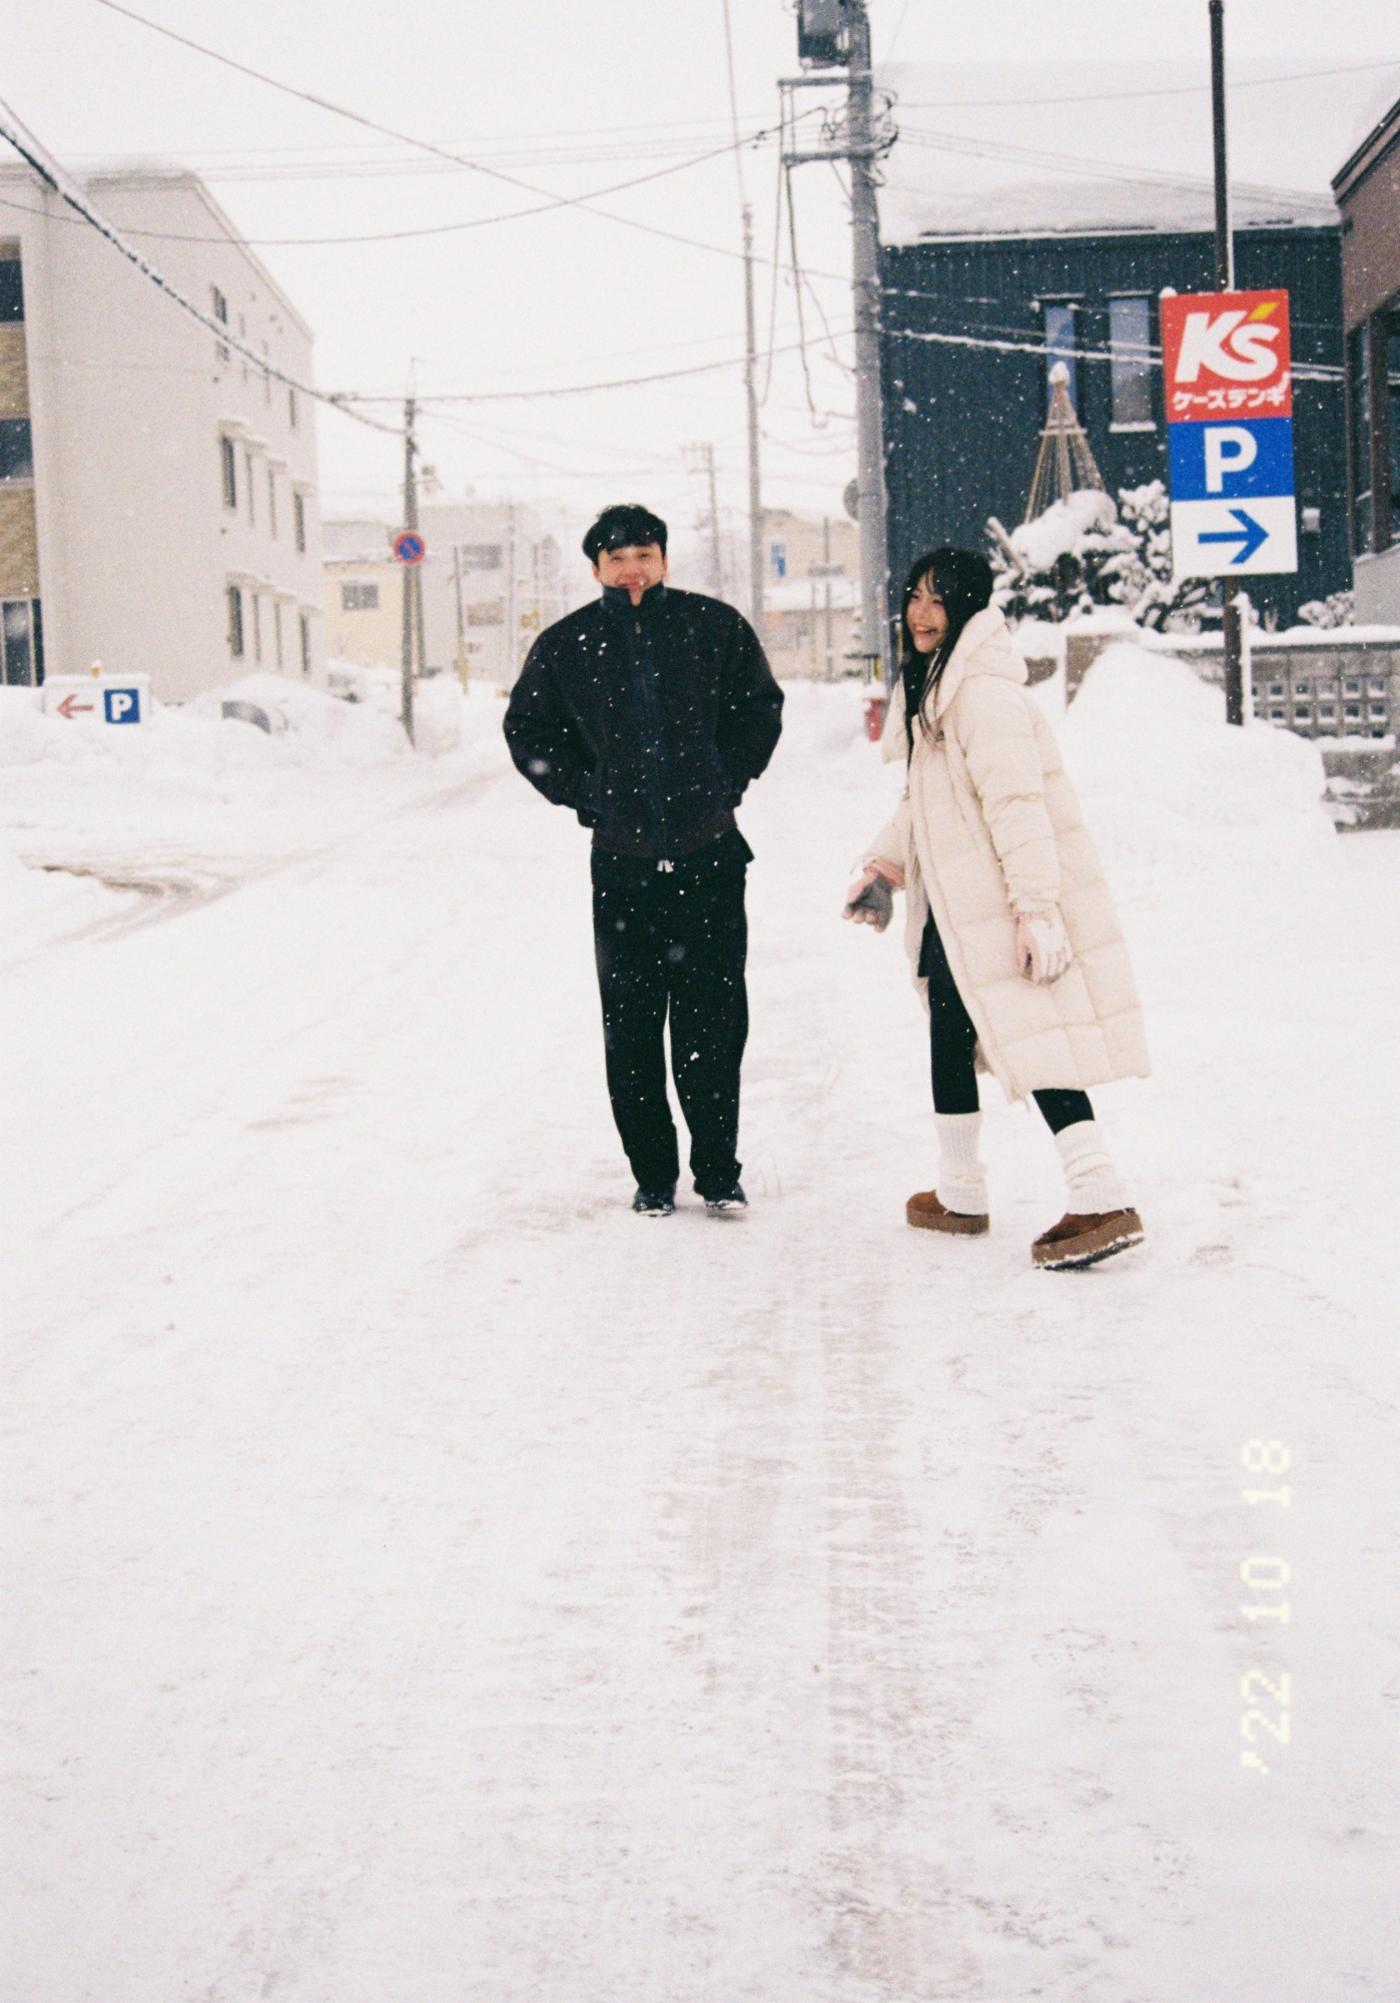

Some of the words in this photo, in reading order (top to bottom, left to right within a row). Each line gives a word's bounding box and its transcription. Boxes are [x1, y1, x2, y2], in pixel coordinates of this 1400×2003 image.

[1174, 302, 1280, 383] K's
[1173, 385, 1287, 411] ケーズデンキ
[1204, 426, 1258, 493] P
[110, 692, 134, 721] P
